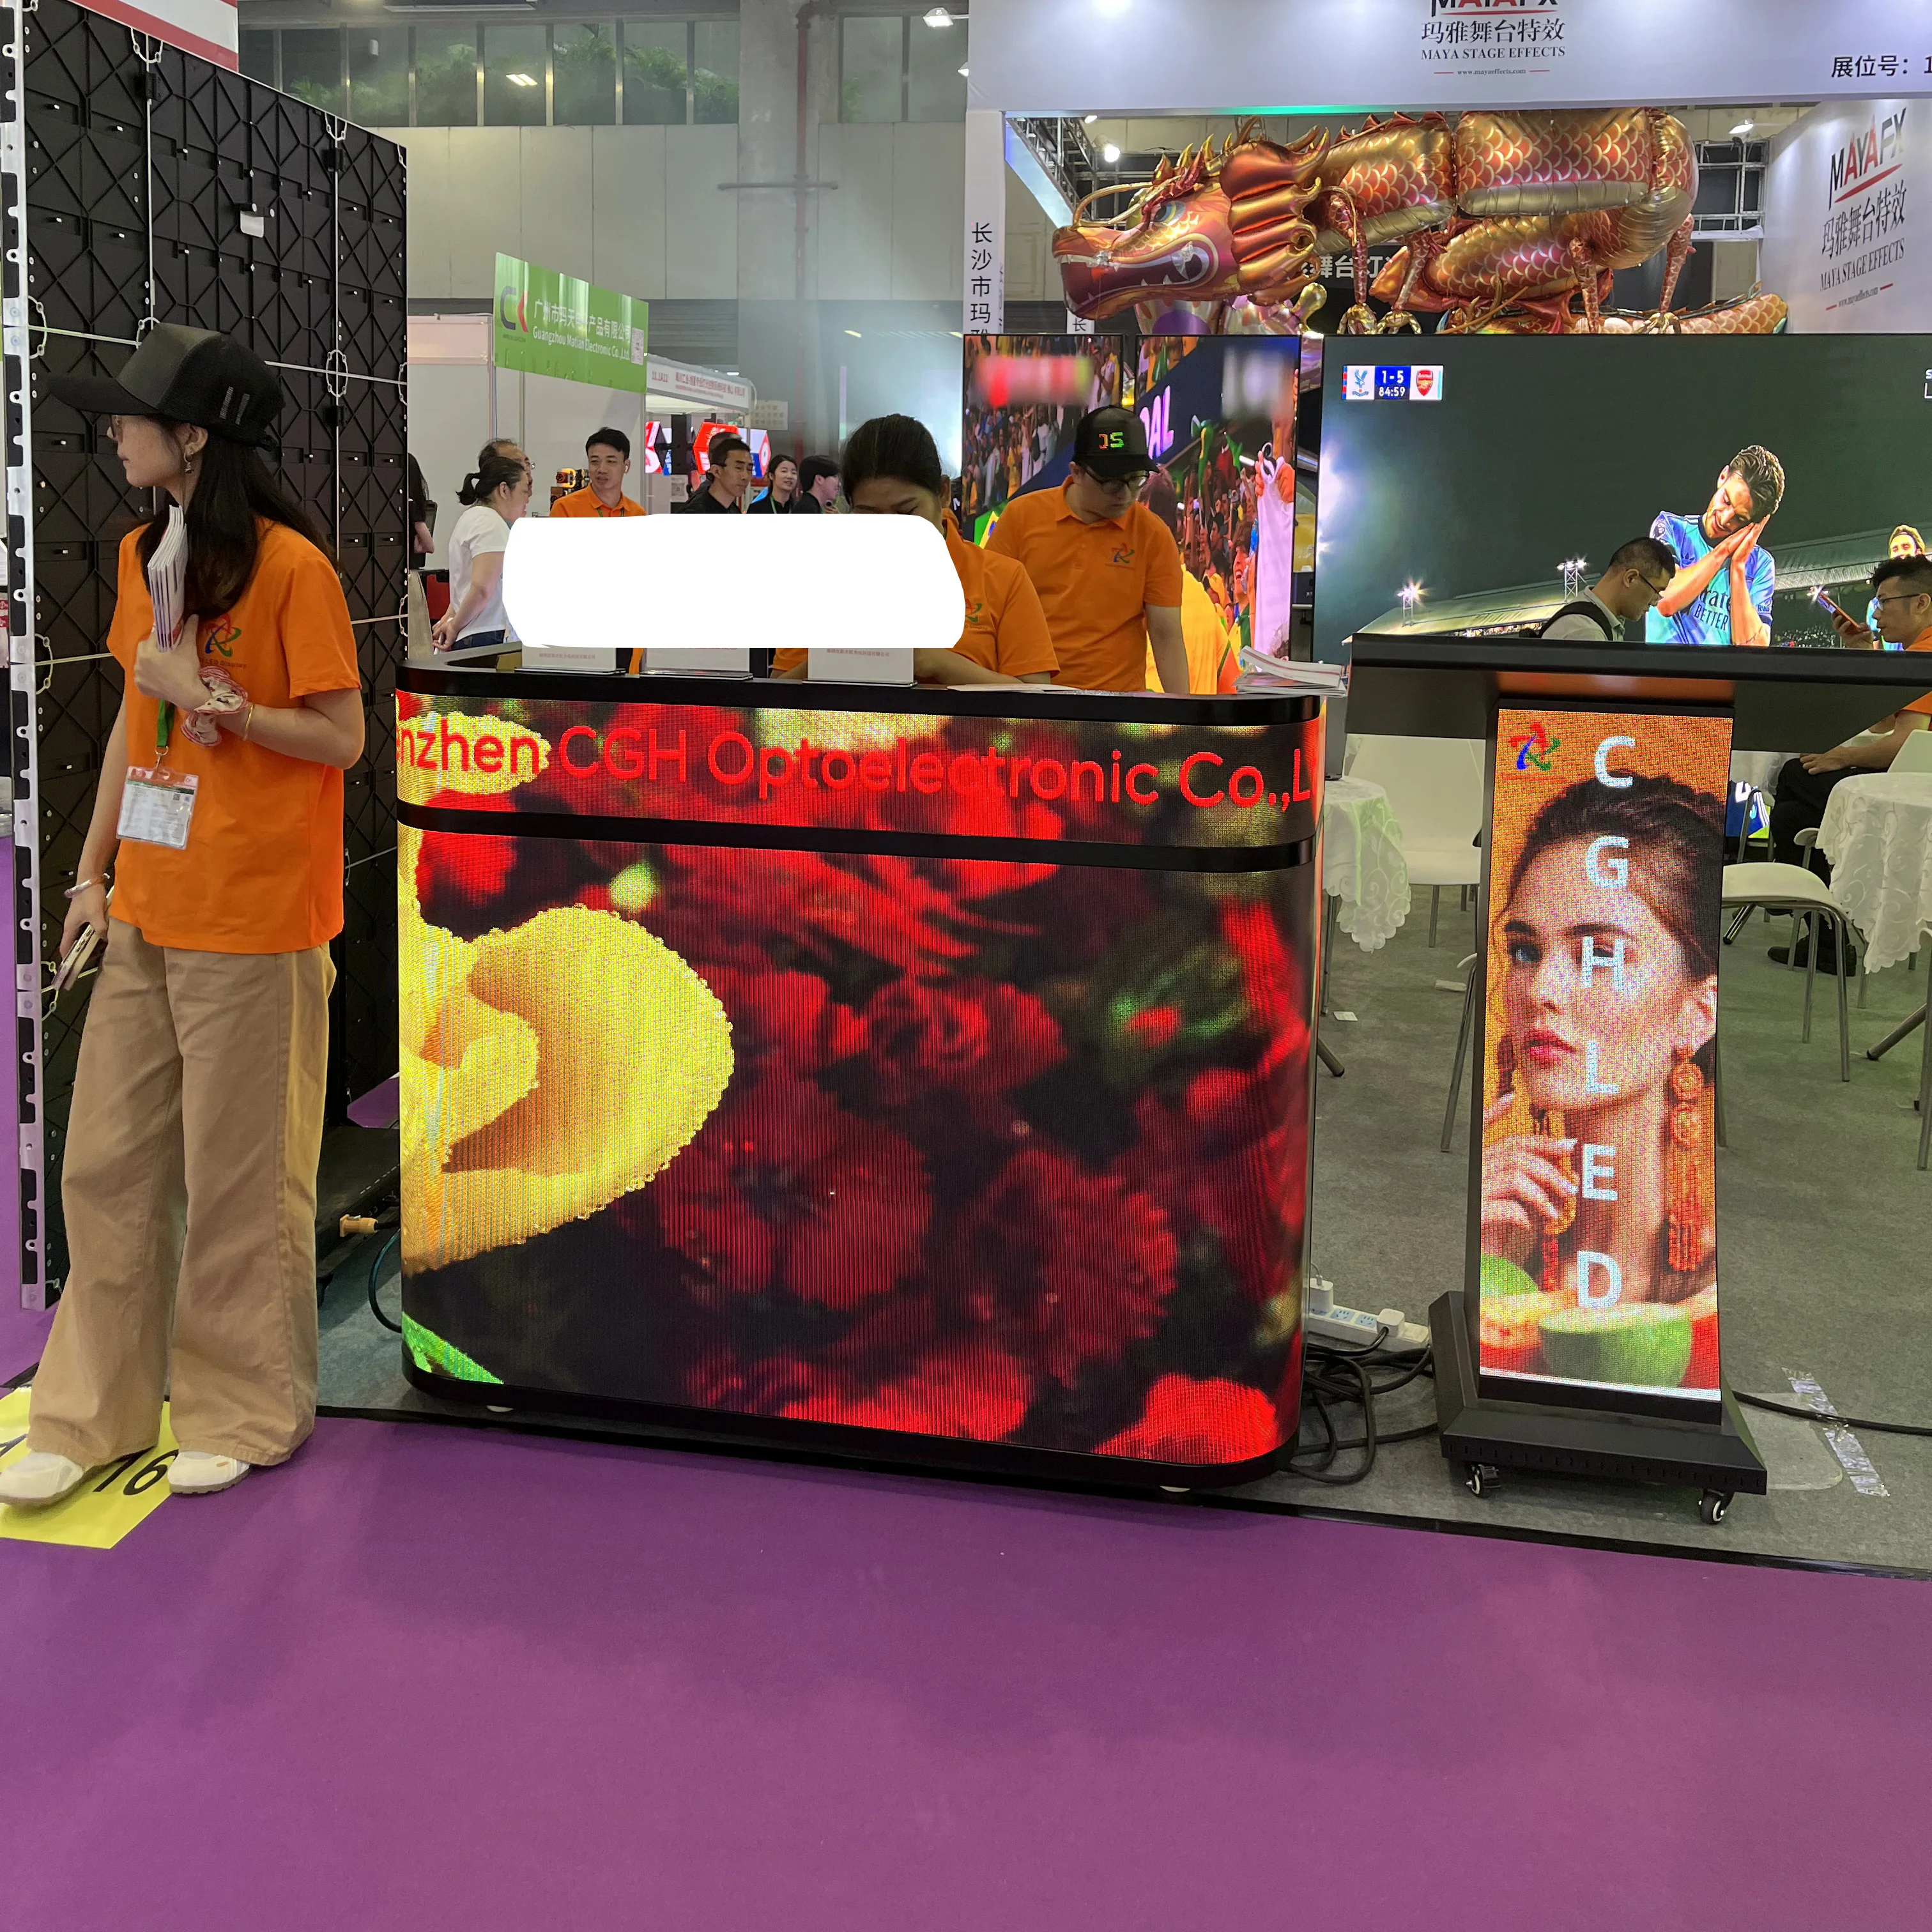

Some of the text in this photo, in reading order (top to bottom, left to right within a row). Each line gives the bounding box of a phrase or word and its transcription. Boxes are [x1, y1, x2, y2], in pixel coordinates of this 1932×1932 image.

[1421, 18, 1565, 43] 玛雅舞台特效
[1421, 46, 1565, 59] MAYA STAGE EFFECTS
[1828, 107, 1906, 211] MAYAFX
[1821, 179, 1906, 260] 玛雅舞台特效
[970, 222, 992, 334] 长沙市玛
[1820, 238, 1905, 292] MAYA STAGE EFFECTS
[533, 325, 566, 346] Guangzhou
[1378, 387, 1406, 397] 84:59
[1694, 604, 1729, 631] BETTER
[395, 717, 540, 776] nzhen
[558, 726, 687, 782] CGH
[708, 730, 1159, 806] Optoelectronic
